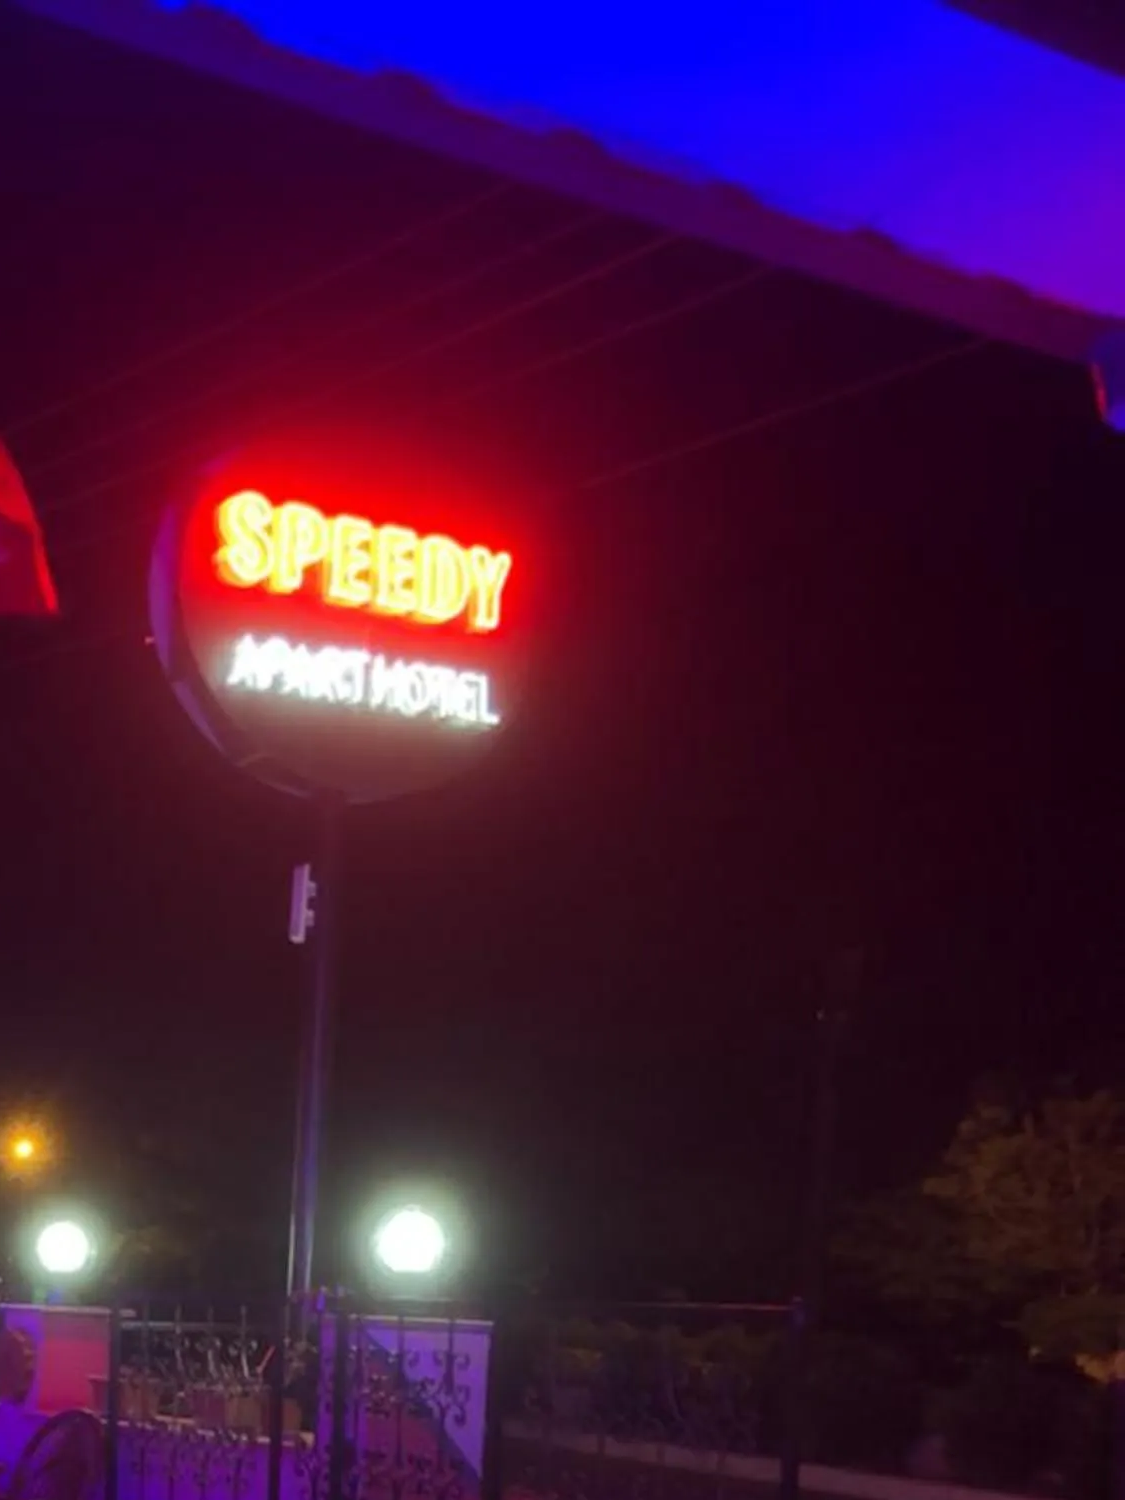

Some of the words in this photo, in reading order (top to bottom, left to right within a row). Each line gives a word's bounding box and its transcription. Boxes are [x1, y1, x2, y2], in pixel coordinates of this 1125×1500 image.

[215, 490, 512, 632] SPEEDY
[227, 634, 369, 704] APART
[370, 654, 500, 726] HOTEL
